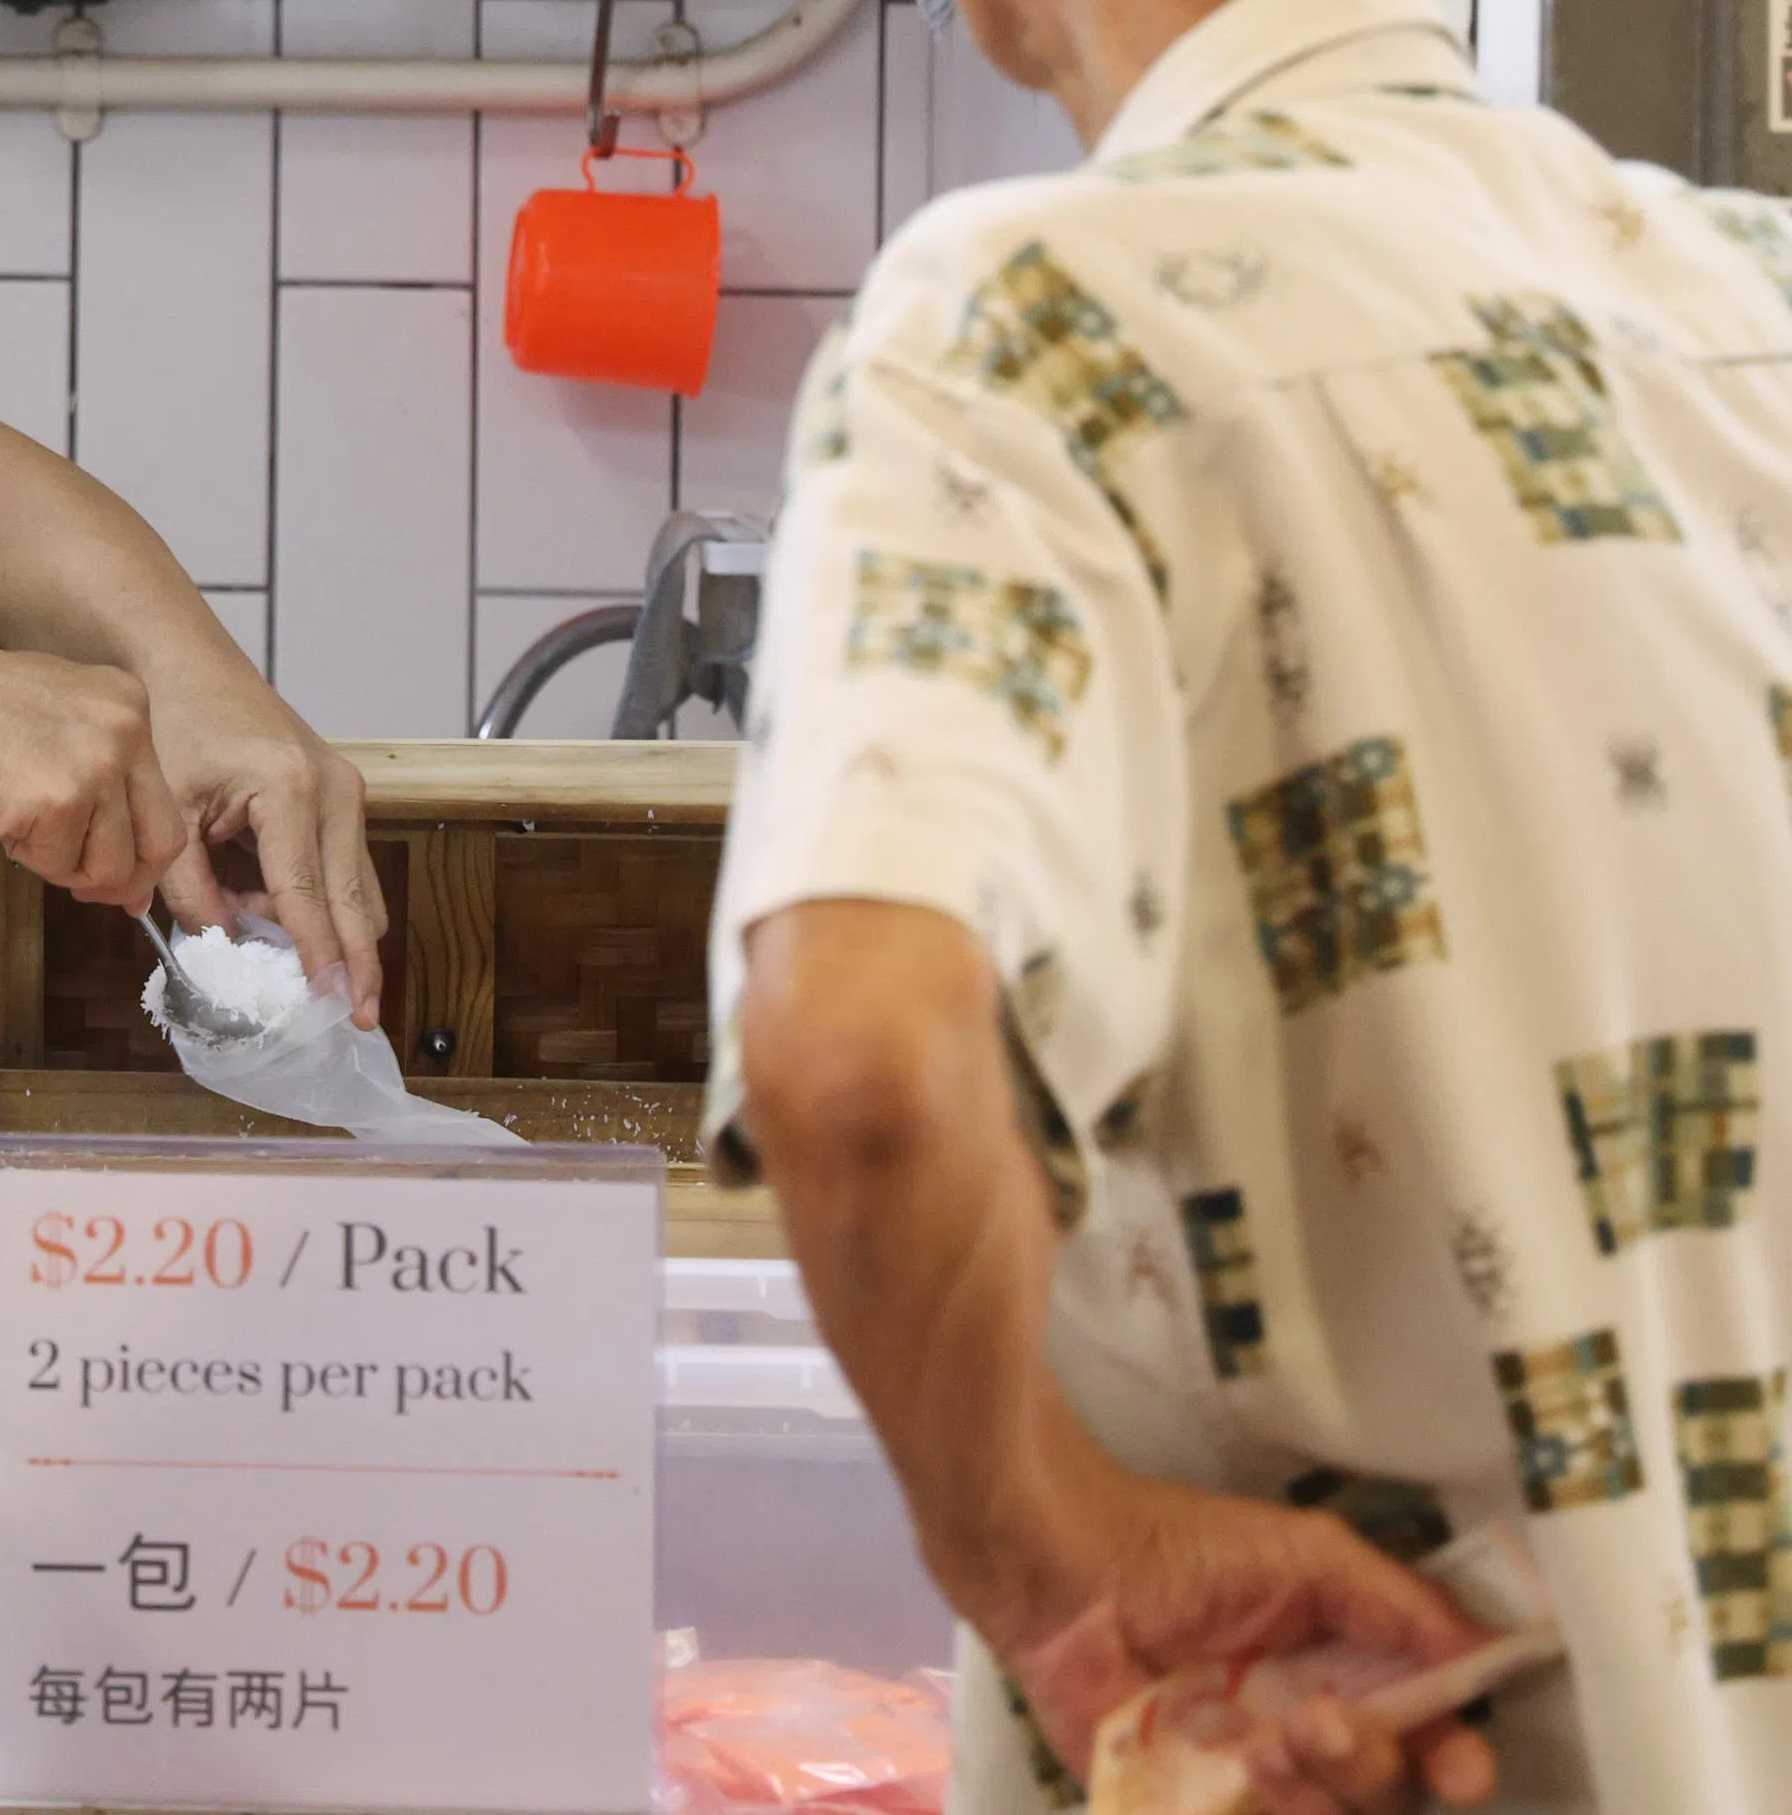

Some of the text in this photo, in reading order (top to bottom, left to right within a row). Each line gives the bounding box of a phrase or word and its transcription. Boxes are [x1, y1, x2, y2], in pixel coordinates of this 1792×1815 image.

[31, 1211, 526, 1295] $2.20 / Pack
[27, 1340, 533, 1416] 2 pieces per pack
[31, 1532, 509, 1616] 一包 / $2.20
[30, 1663, 350, 1731] 每包有两片
